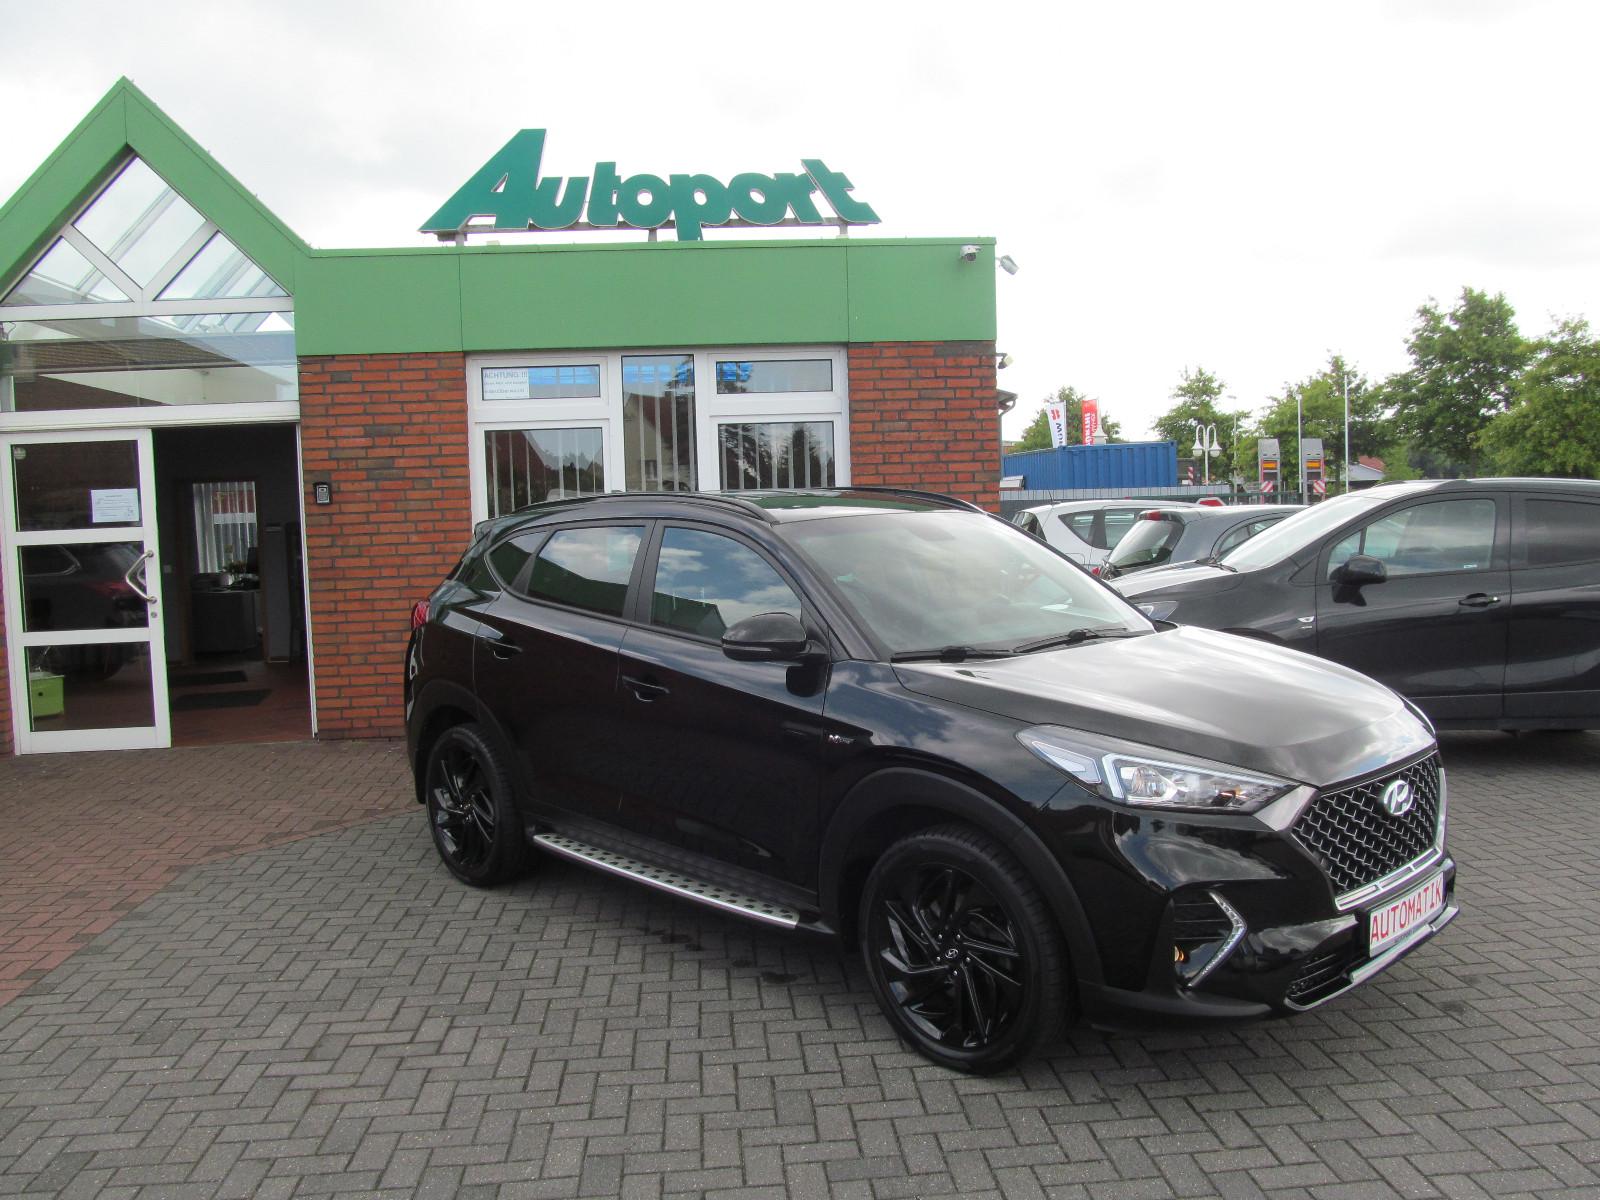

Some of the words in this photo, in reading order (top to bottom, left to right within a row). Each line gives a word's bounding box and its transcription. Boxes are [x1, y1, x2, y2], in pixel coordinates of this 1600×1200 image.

[418, 128, 882, 241] Autoport
[484, 371, 519, 379] ACHTUNG
[1371, 879, 1442, 944] AUTOMATIK
